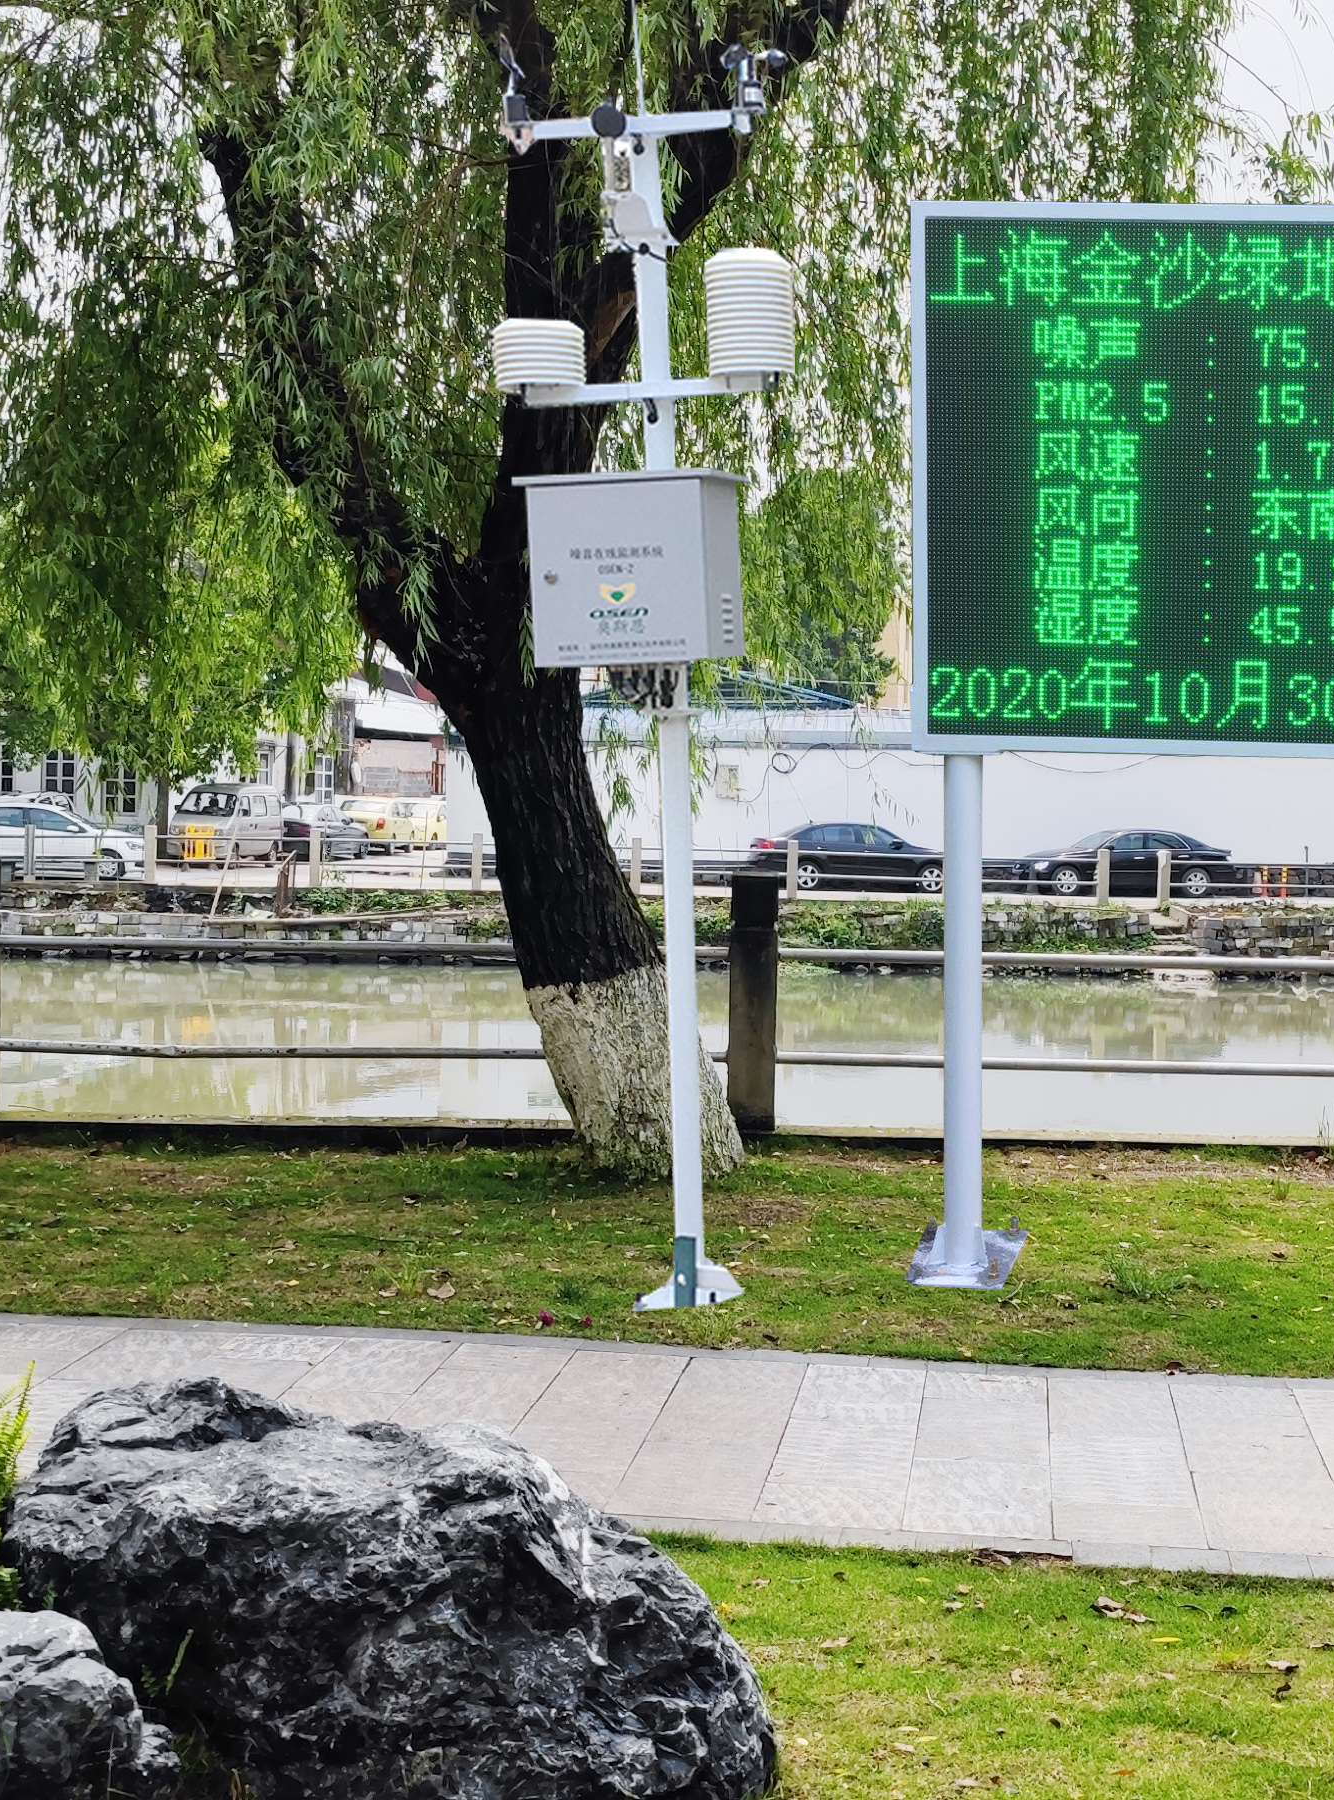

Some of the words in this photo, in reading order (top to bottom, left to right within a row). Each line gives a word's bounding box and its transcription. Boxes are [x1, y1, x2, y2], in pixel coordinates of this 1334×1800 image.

[1034, 315, 1142, 369] 噪声
[1034, 381, 1169, 424] PM2.5
[1034, 429, 1141, 482] 风速
[1255, 439, 1333, 482] 1.7
[1034, 484, 1141, 537] 风向
[1034, 538, 1140, 591] 温度
[1034, 592, 1139, 646] 湿度
